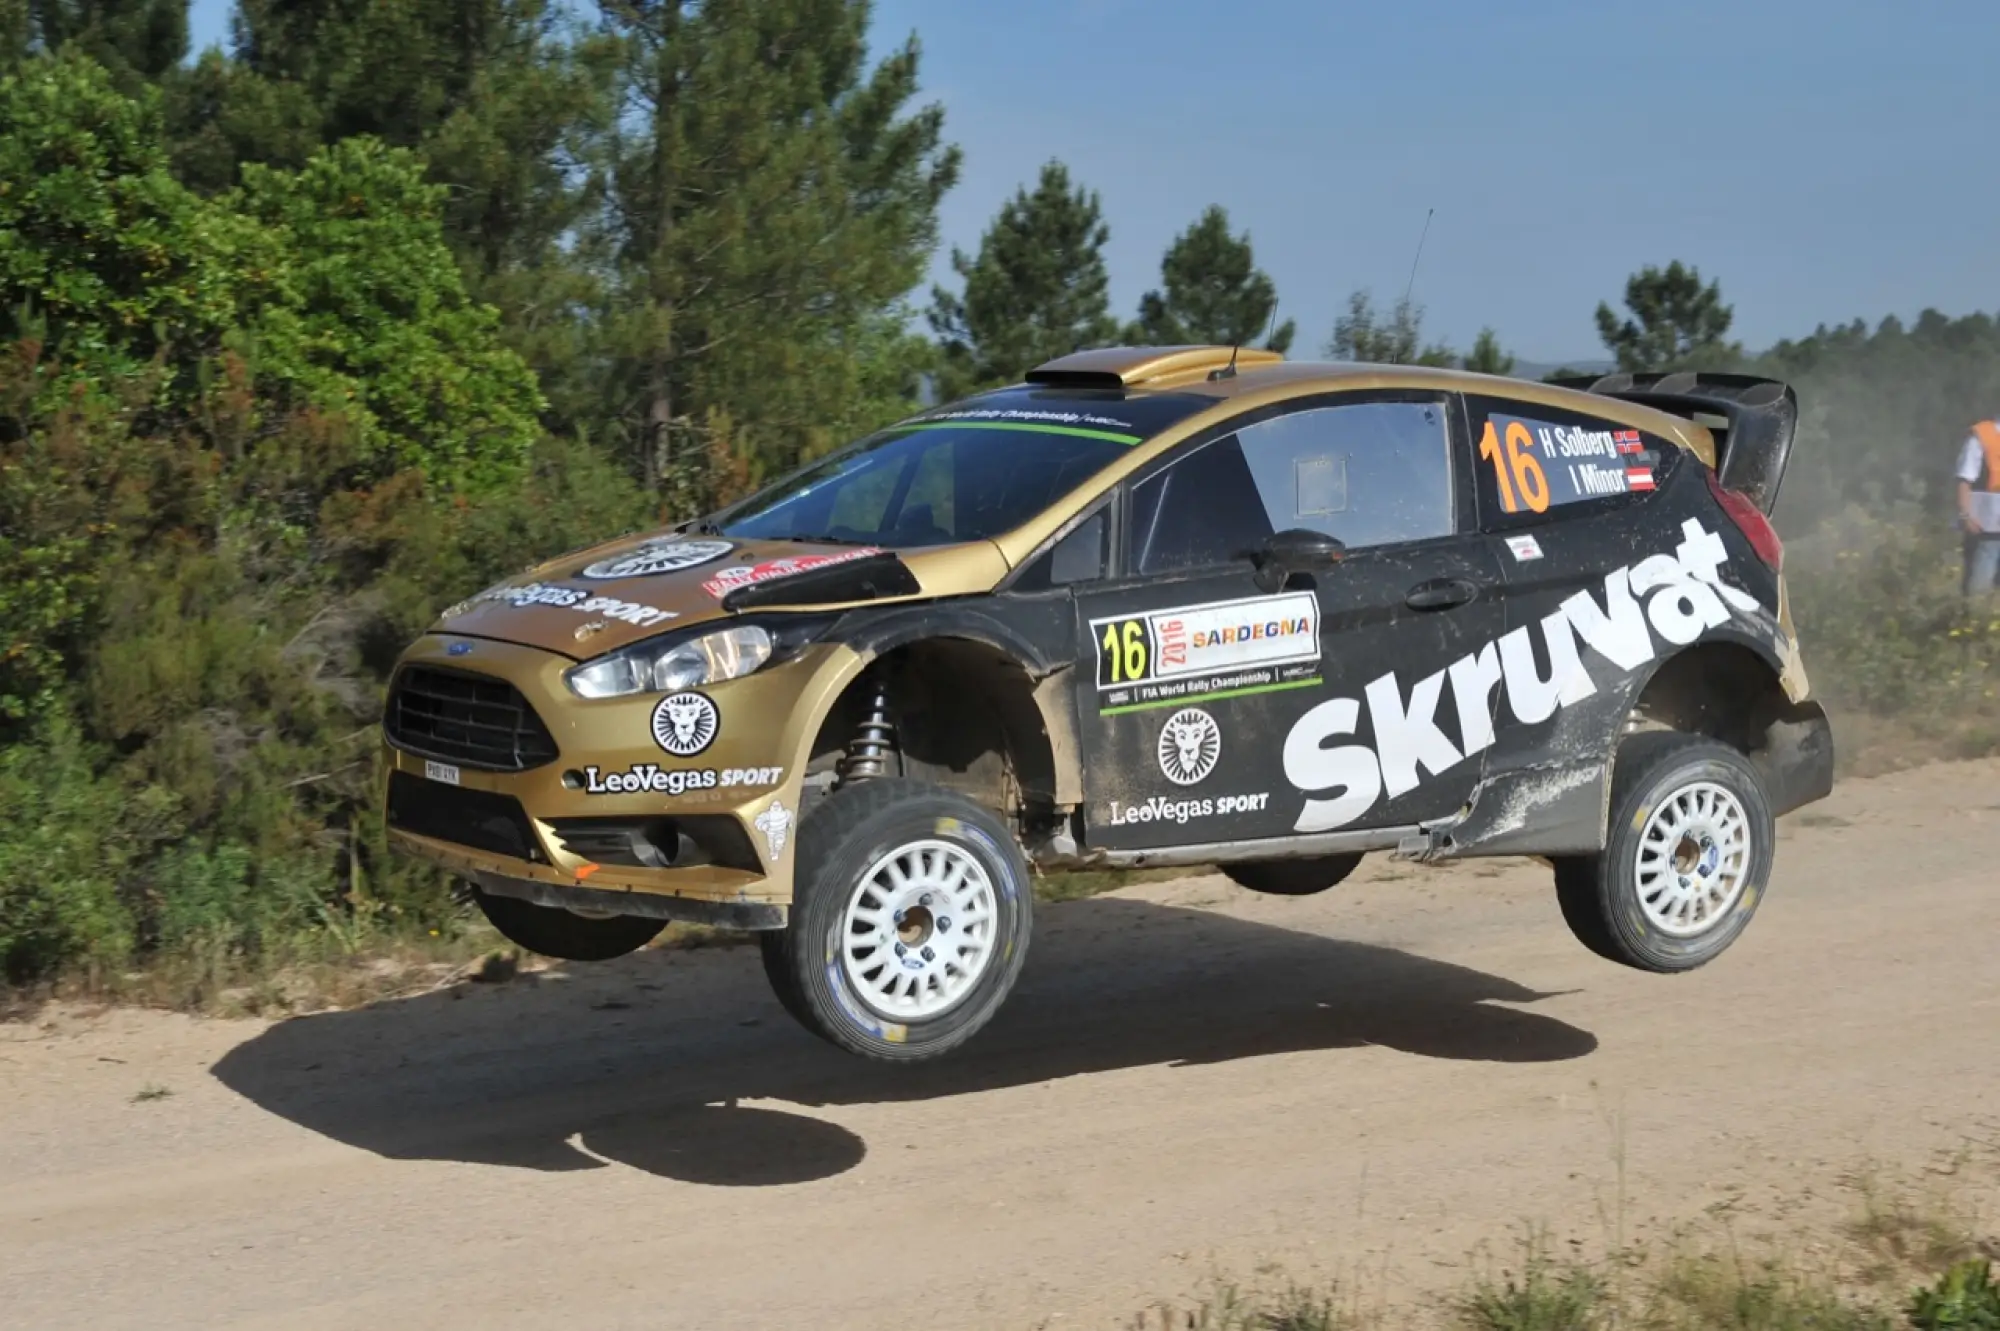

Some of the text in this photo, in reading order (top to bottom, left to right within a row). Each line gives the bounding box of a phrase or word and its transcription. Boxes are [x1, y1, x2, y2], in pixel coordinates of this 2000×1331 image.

[1538, 426, 1618, 459] H Solberg
[1480, 421, 1550, 514] 16
[1568, 463, 1626, 495] I Minor
[572, 597, 681, 627] SPORT
[1159, 619, 1187, 667] 2016
[1193, 617, 1310, 648] SARDEGNA
[1102, 620, 1146, 682] 16
[1142, 686, 1159, 699] FIA
[1159, 682, 1186, 697] World
[1187, 679, 1210, 693] Rally
[1211, 670, 1272, 689] Championship
[585, 765, 784, 795] LeoVegas SPORT
[1110, 792, 1270, 825] LeoVegas SPORT
